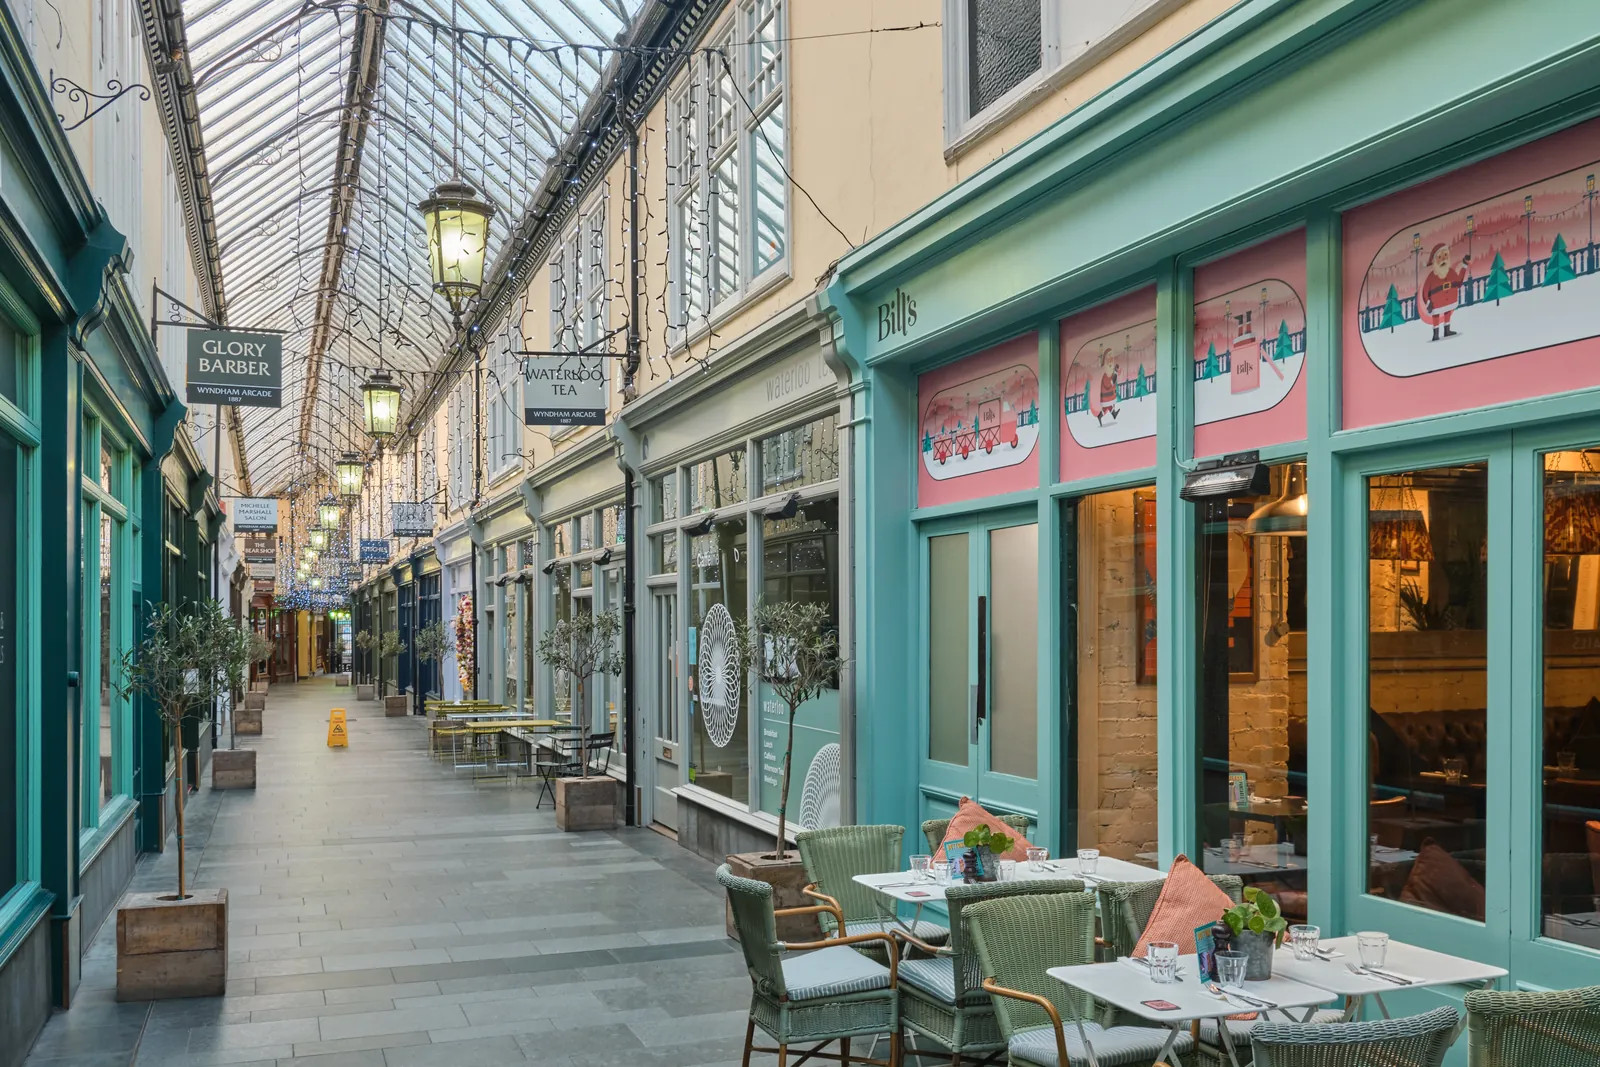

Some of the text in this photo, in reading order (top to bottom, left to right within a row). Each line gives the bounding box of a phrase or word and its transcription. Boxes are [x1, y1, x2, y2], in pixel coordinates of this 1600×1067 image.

[877, 287, 918, 342] Bill's
[202, 340, 267, 357] GLORY
[199, 358, 271, 376] BARBER
[526, 368, 603, 381] WATERLOO
[766, 361, 811, 402] waterloo
[197, 386, 273, 397] WYNDHAM ARCADE
[551, 384, 578, 396] TEA
[763, 699, 785, 715] waterloo
